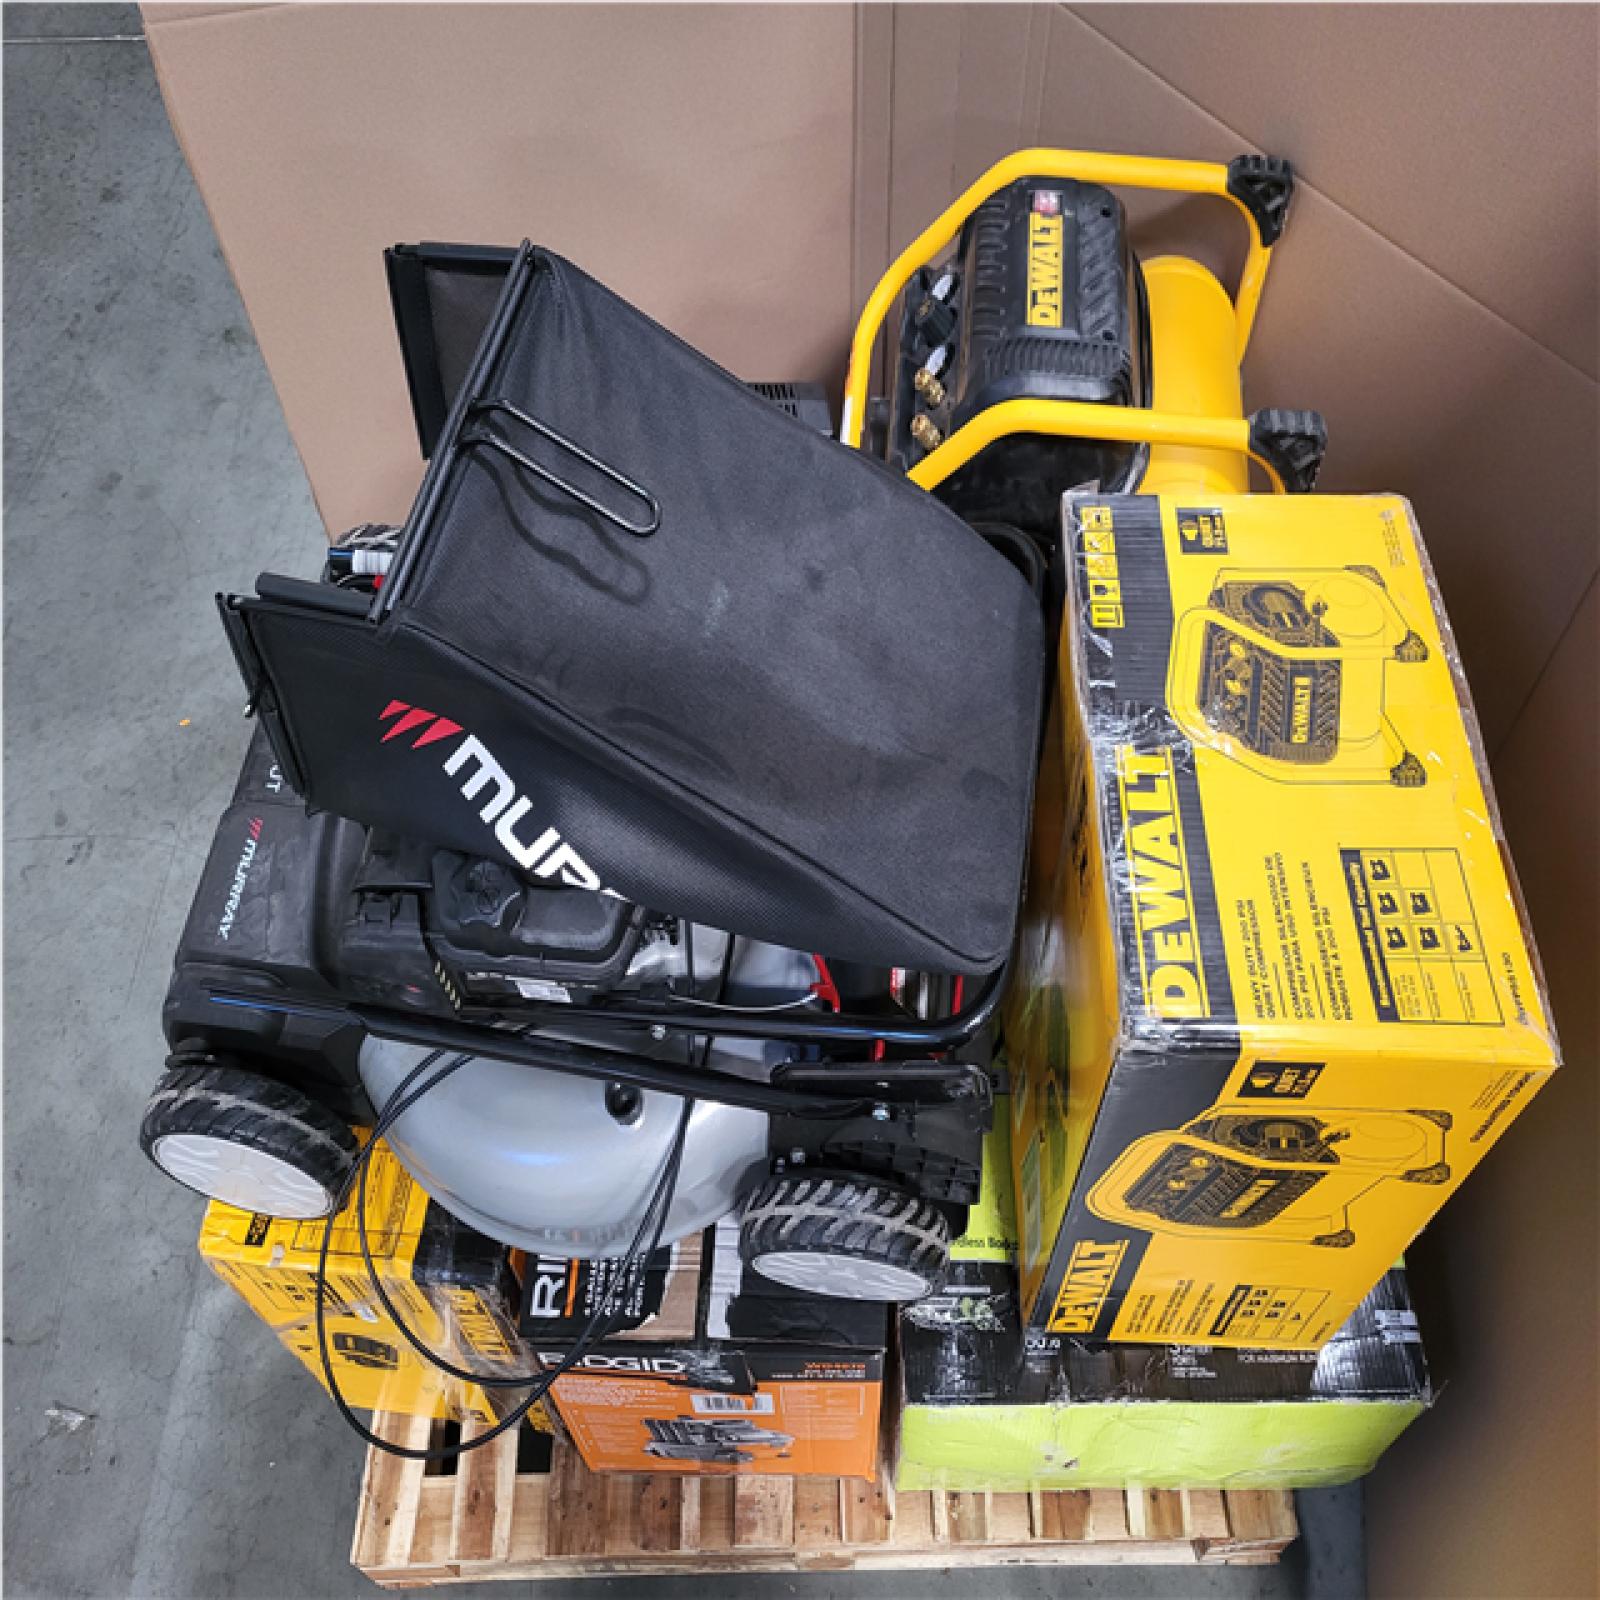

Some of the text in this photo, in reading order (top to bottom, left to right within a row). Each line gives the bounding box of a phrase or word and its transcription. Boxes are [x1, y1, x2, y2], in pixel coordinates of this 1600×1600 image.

[1028, 213, 1064, 326] DEWALT
[443, 734, 630, 904] MUR
[217, 838, 257, 941] MURRAY
[1121, 744, 1204, 1019] DEWALT
[1247, 899, 1269, 980] COMPRESSOR
[1049, 1241, 1126, 1332] DEWALT
[537, 1351, 686, 1374] RDGID
